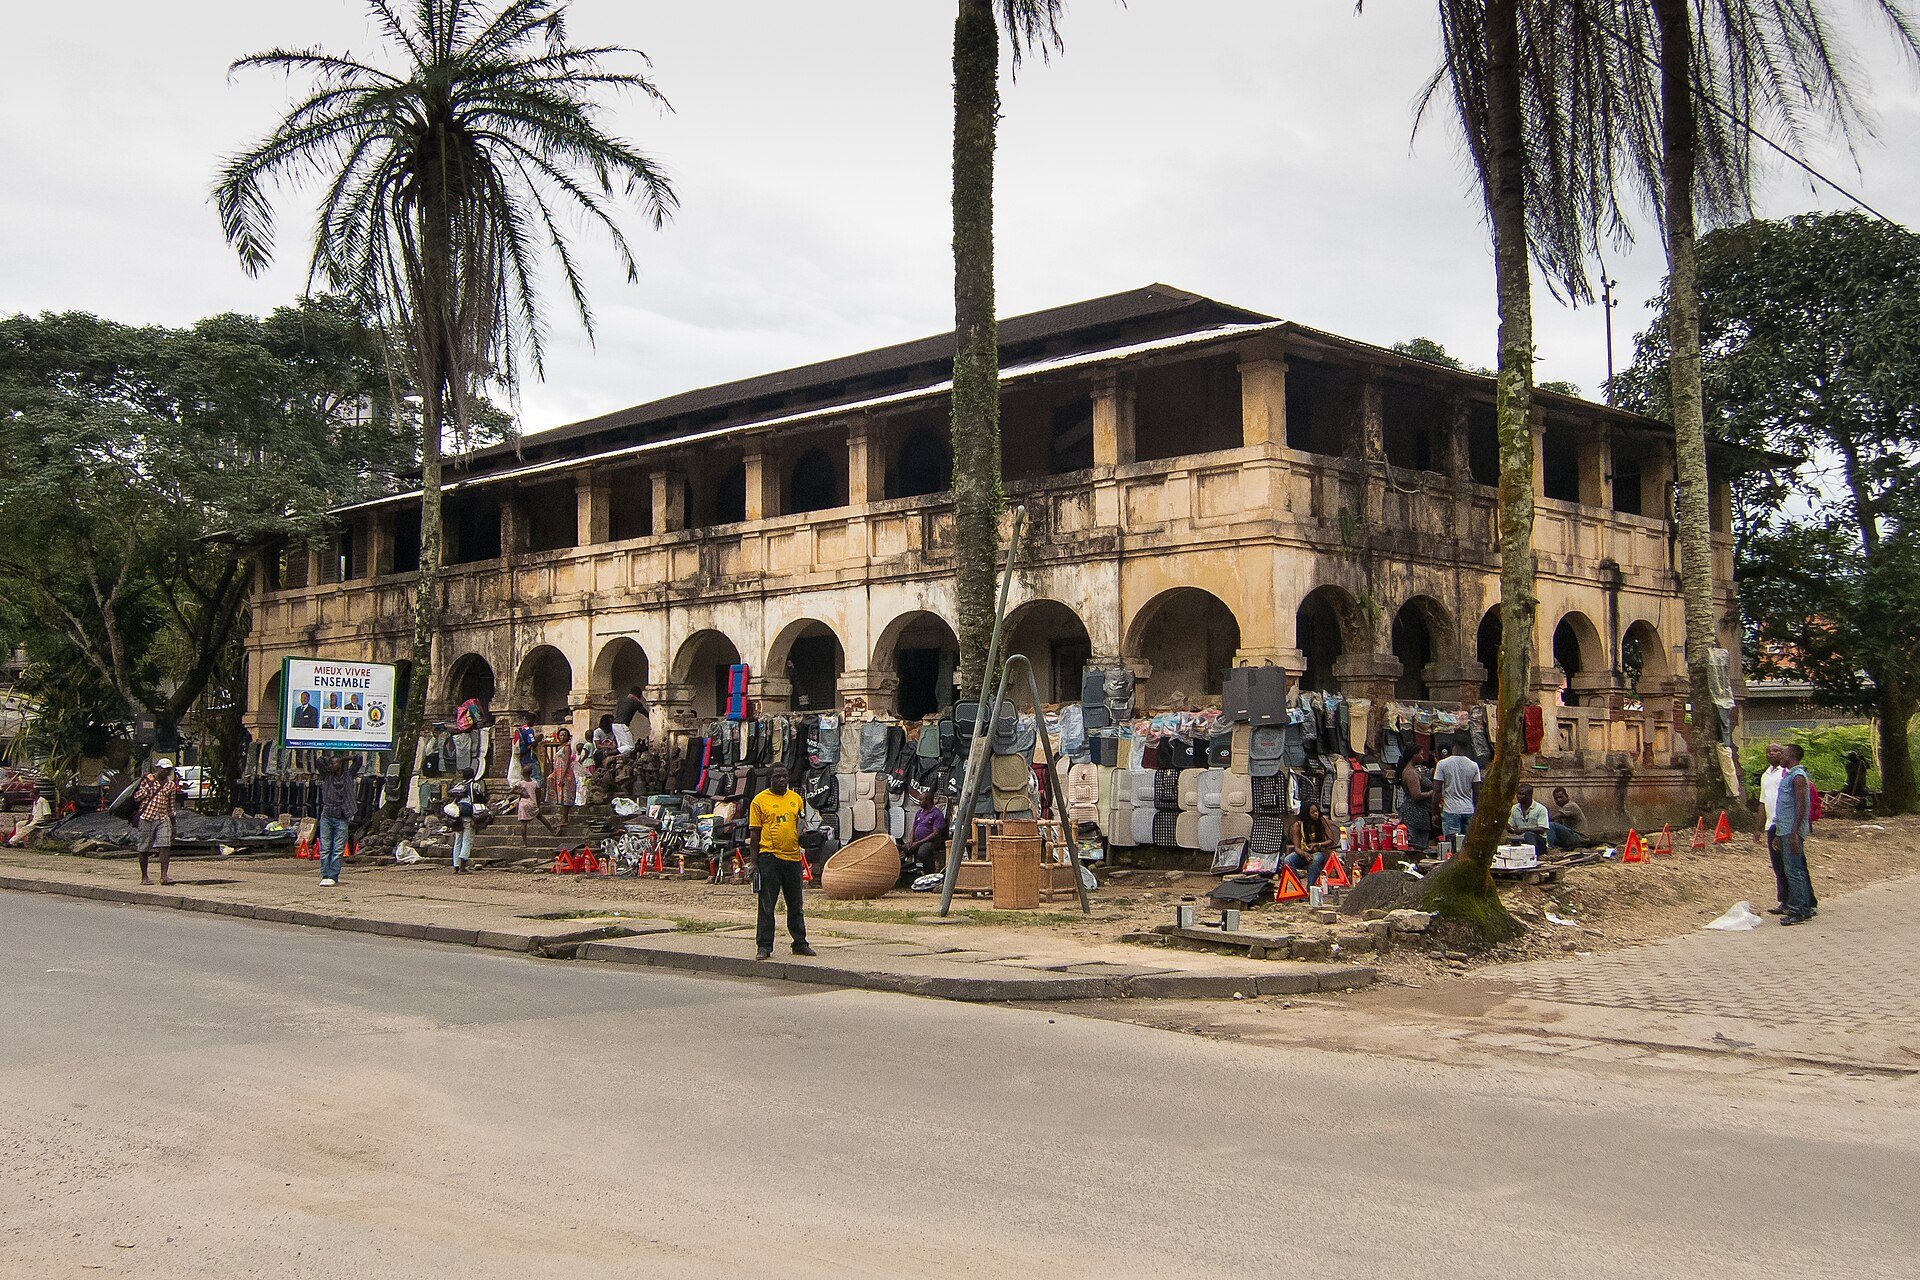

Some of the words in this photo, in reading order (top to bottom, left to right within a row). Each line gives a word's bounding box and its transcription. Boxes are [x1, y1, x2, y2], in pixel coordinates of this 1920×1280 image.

[314, 666, 342, 675] MIEUX
[345, 667, 371, 676] VIVRE
[314, 676, 371, 688] ENSEMBLE
